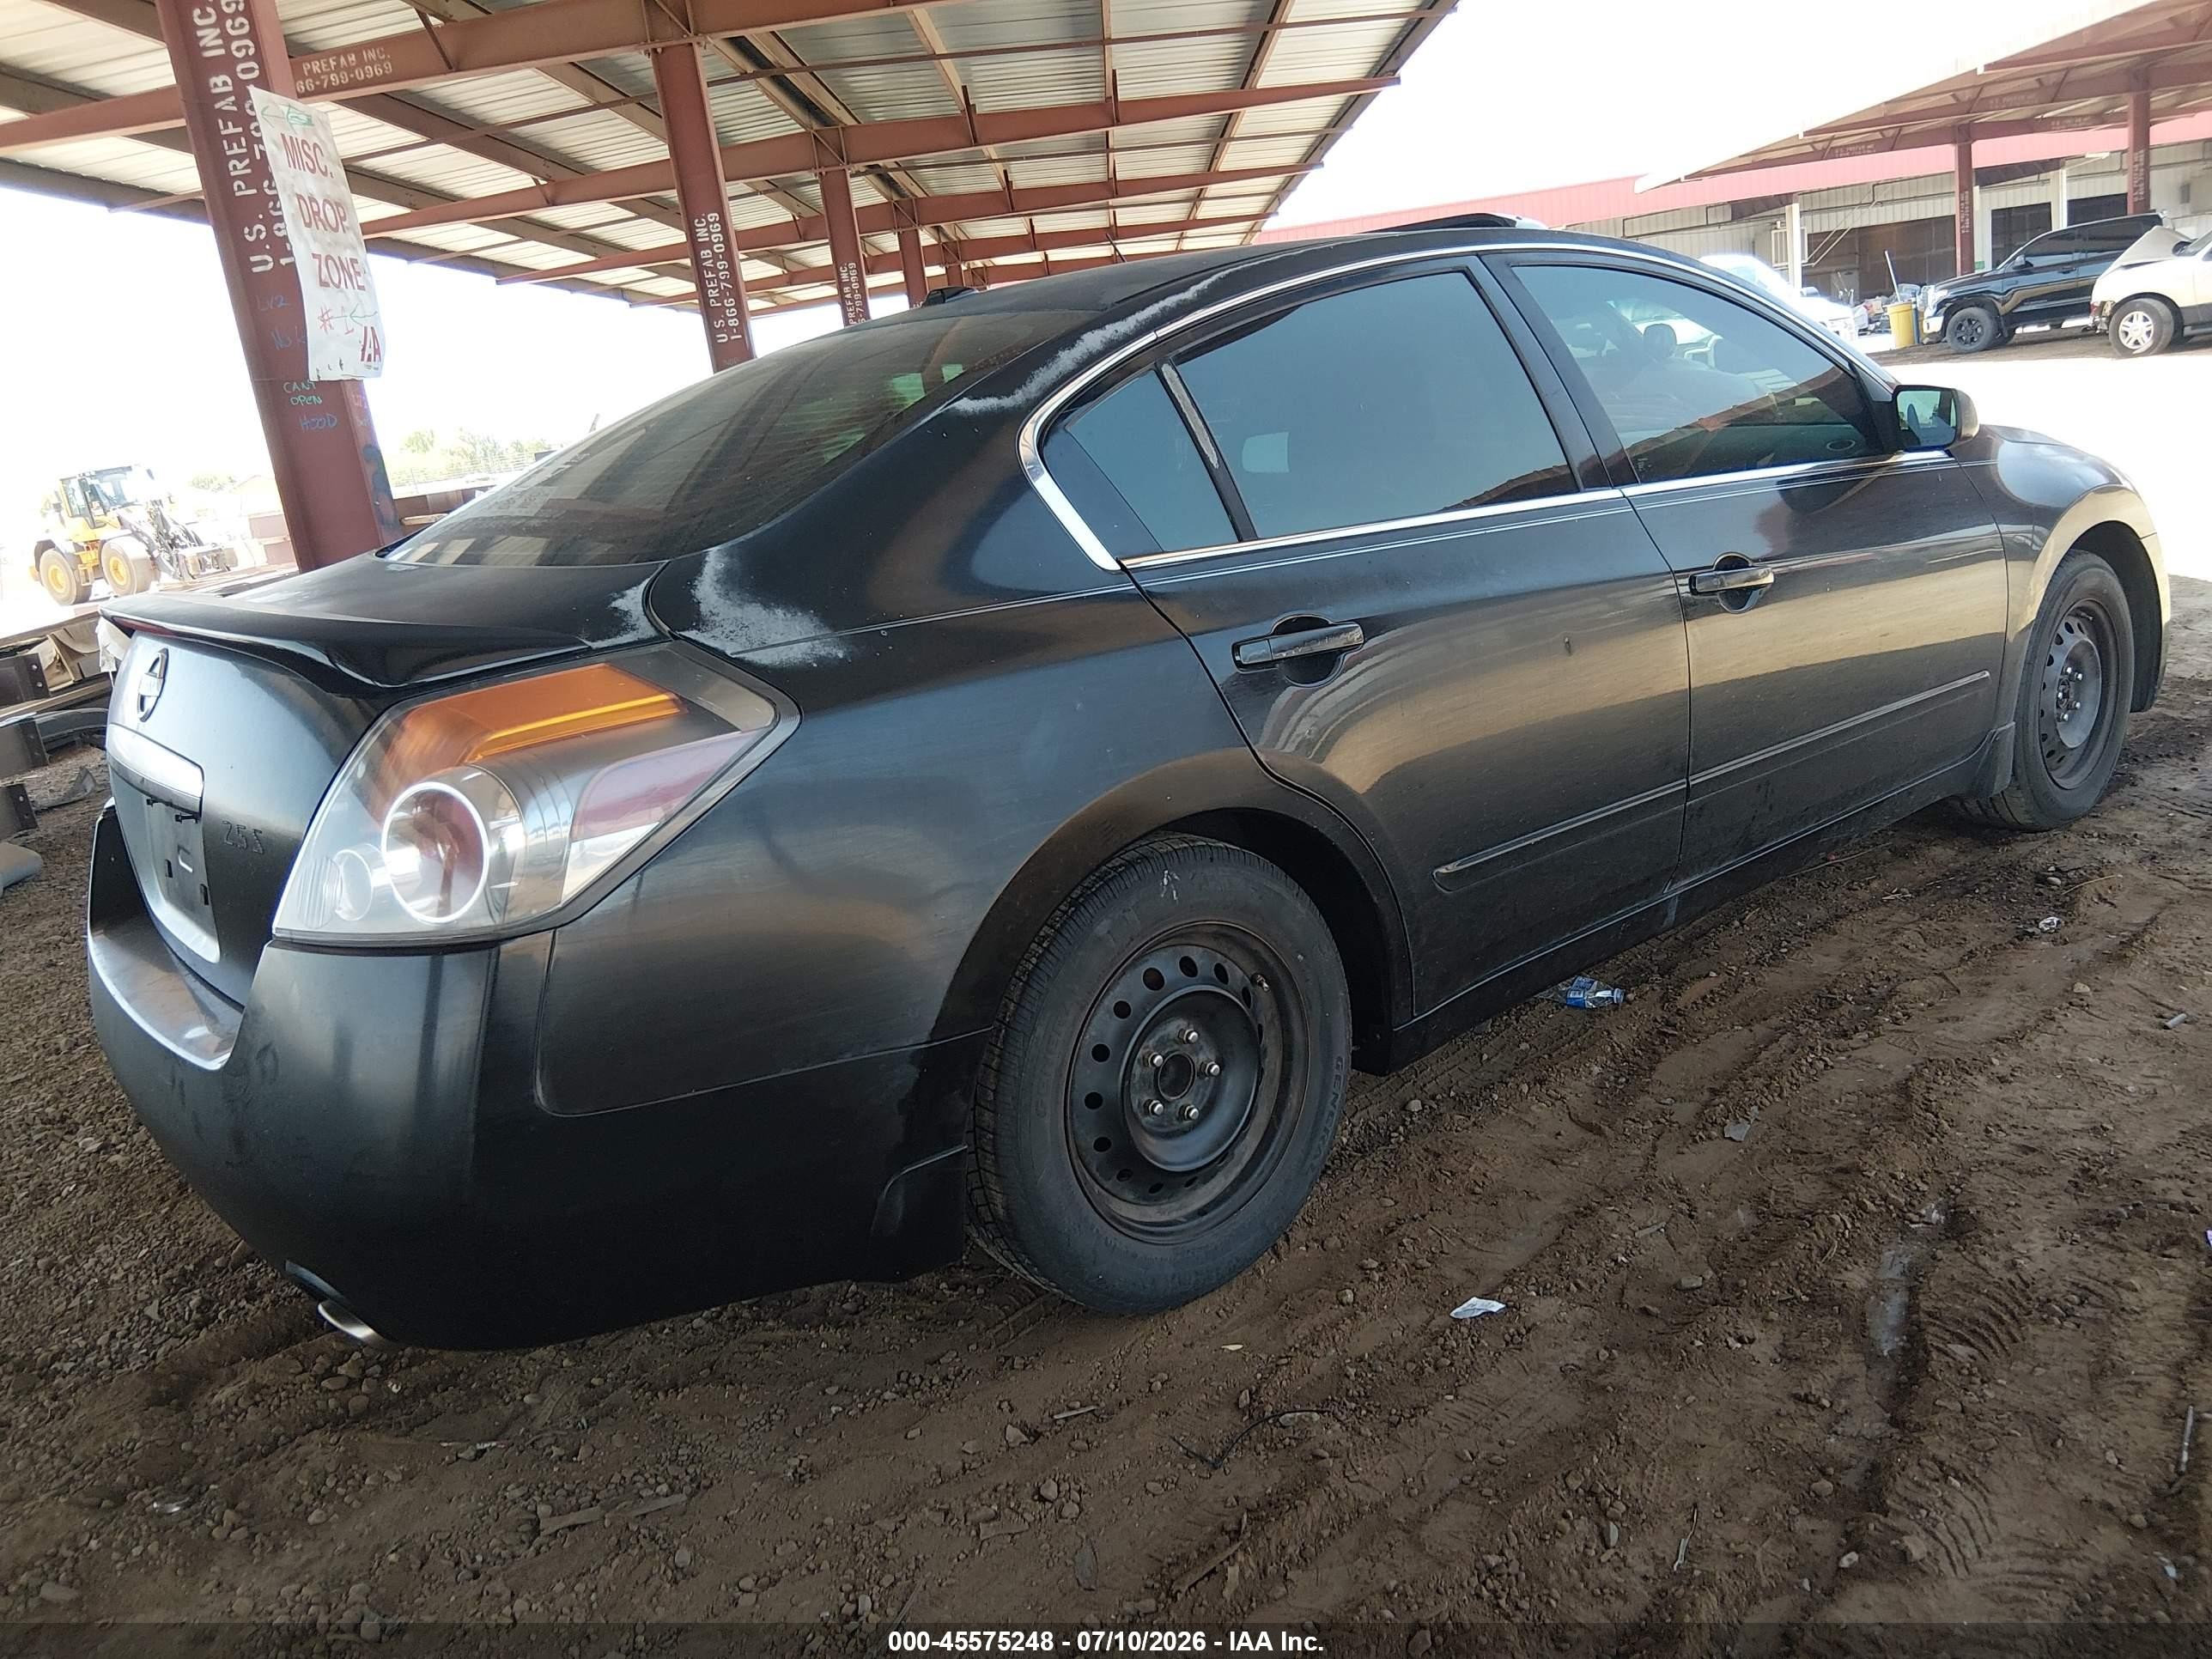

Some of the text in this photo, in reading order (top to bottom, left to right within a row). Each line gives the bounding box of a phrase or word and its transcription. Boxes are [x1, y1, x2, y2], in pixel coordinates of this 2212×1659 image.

[302, 47, 391, 76] PREFAB INC.
[210, 75, 258, 197] PREFAB
[281, 132, 334, 179] MISC.
[244, 213, 274, 272] U.S.
[295, 192, 348, 234] DROP
[311, 252, 366, 291] ZONE
[694, 213, 728, 343] U.S. PREFAB INC.
[707, 212, 743, 340] 1-866-799-0969
[839, 263, 858, 325] PREFAB INC.
